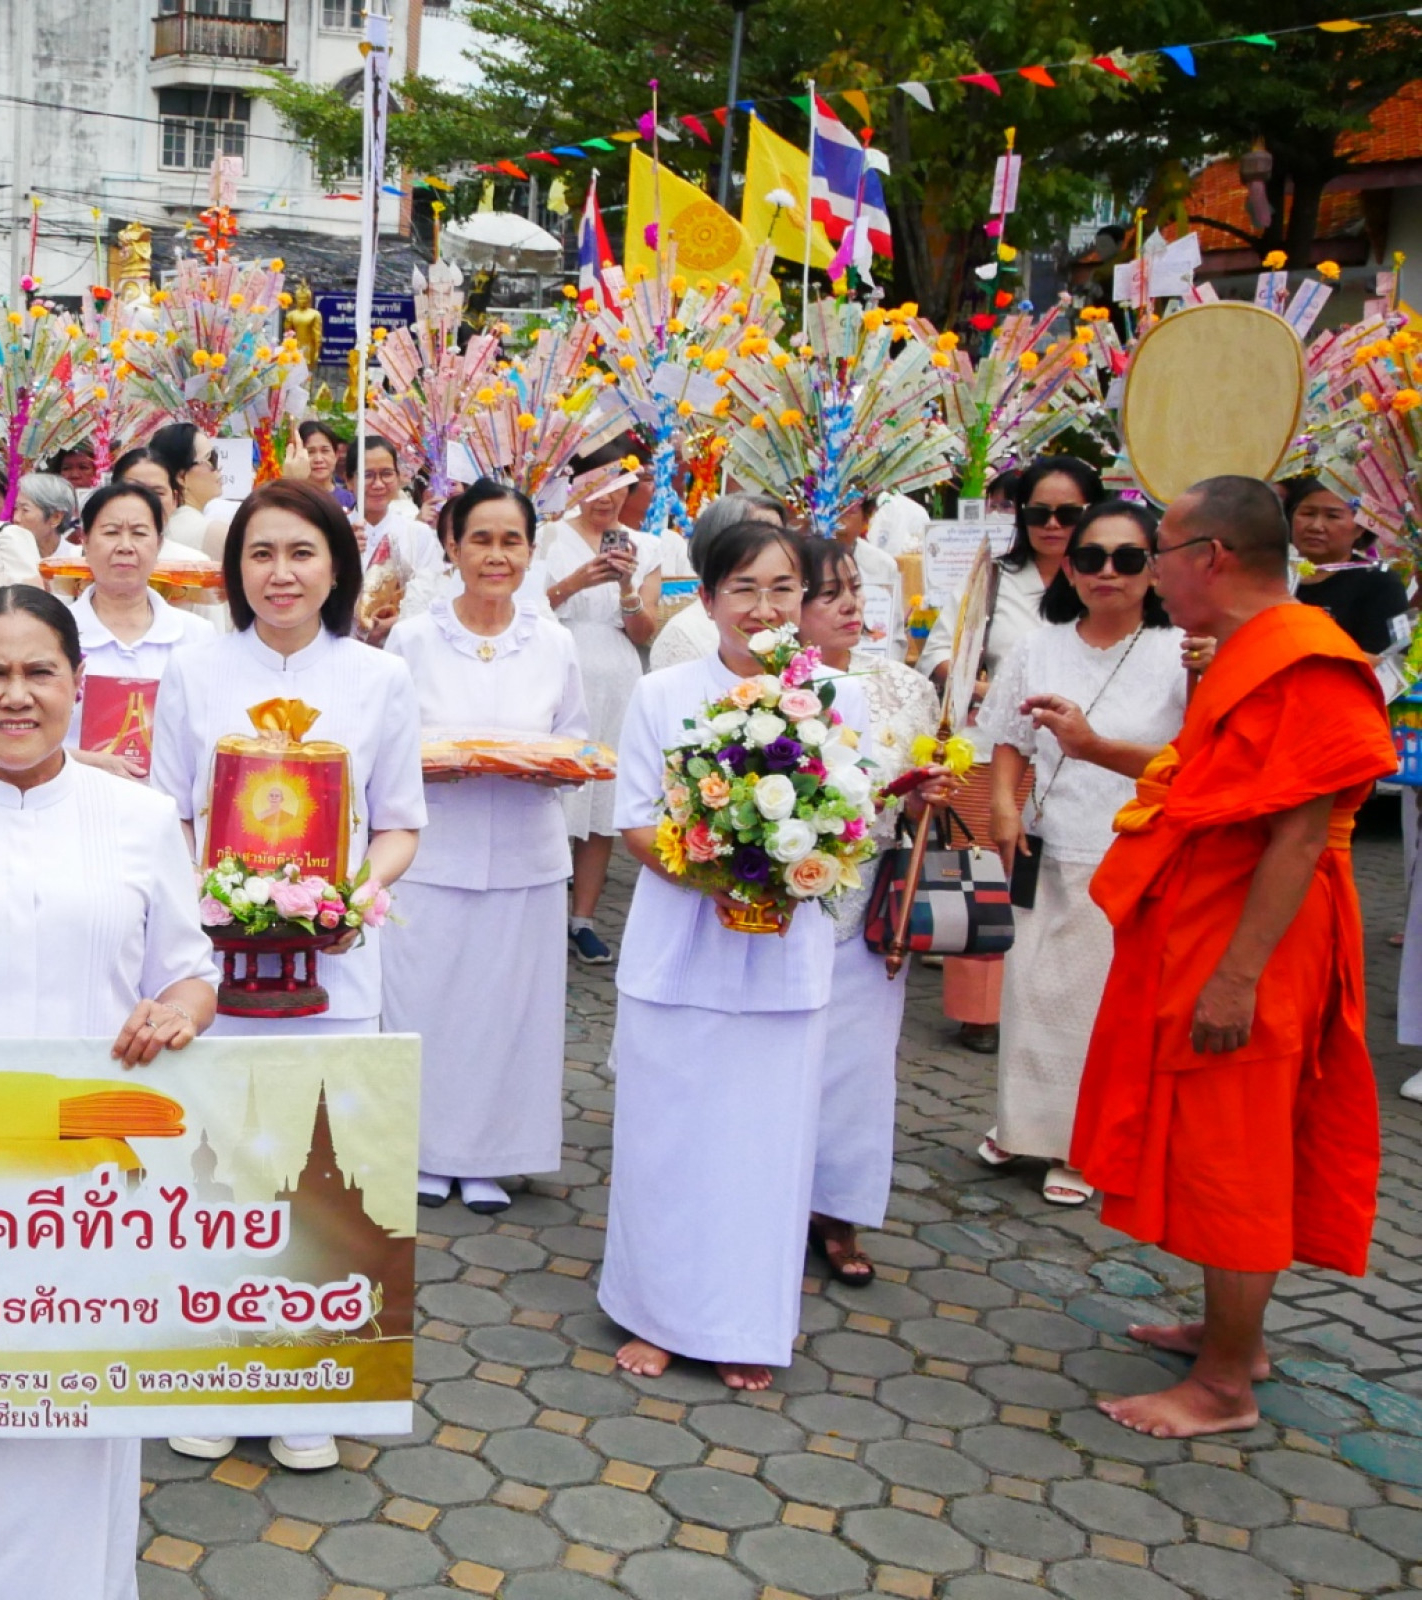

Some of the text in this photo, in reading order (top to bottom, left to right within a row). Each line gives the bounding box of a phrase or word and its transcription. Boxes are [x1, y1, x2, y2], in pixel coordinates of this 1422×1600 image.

[177, 1282, 363, 1324] ๒๕๖๘
[60, 1373, 98, 1391] ๘๑
[110, 1364, 128, 1390] ปี
[139, 1361, 352, 1389] หลวงพ่อธัมมชโย
